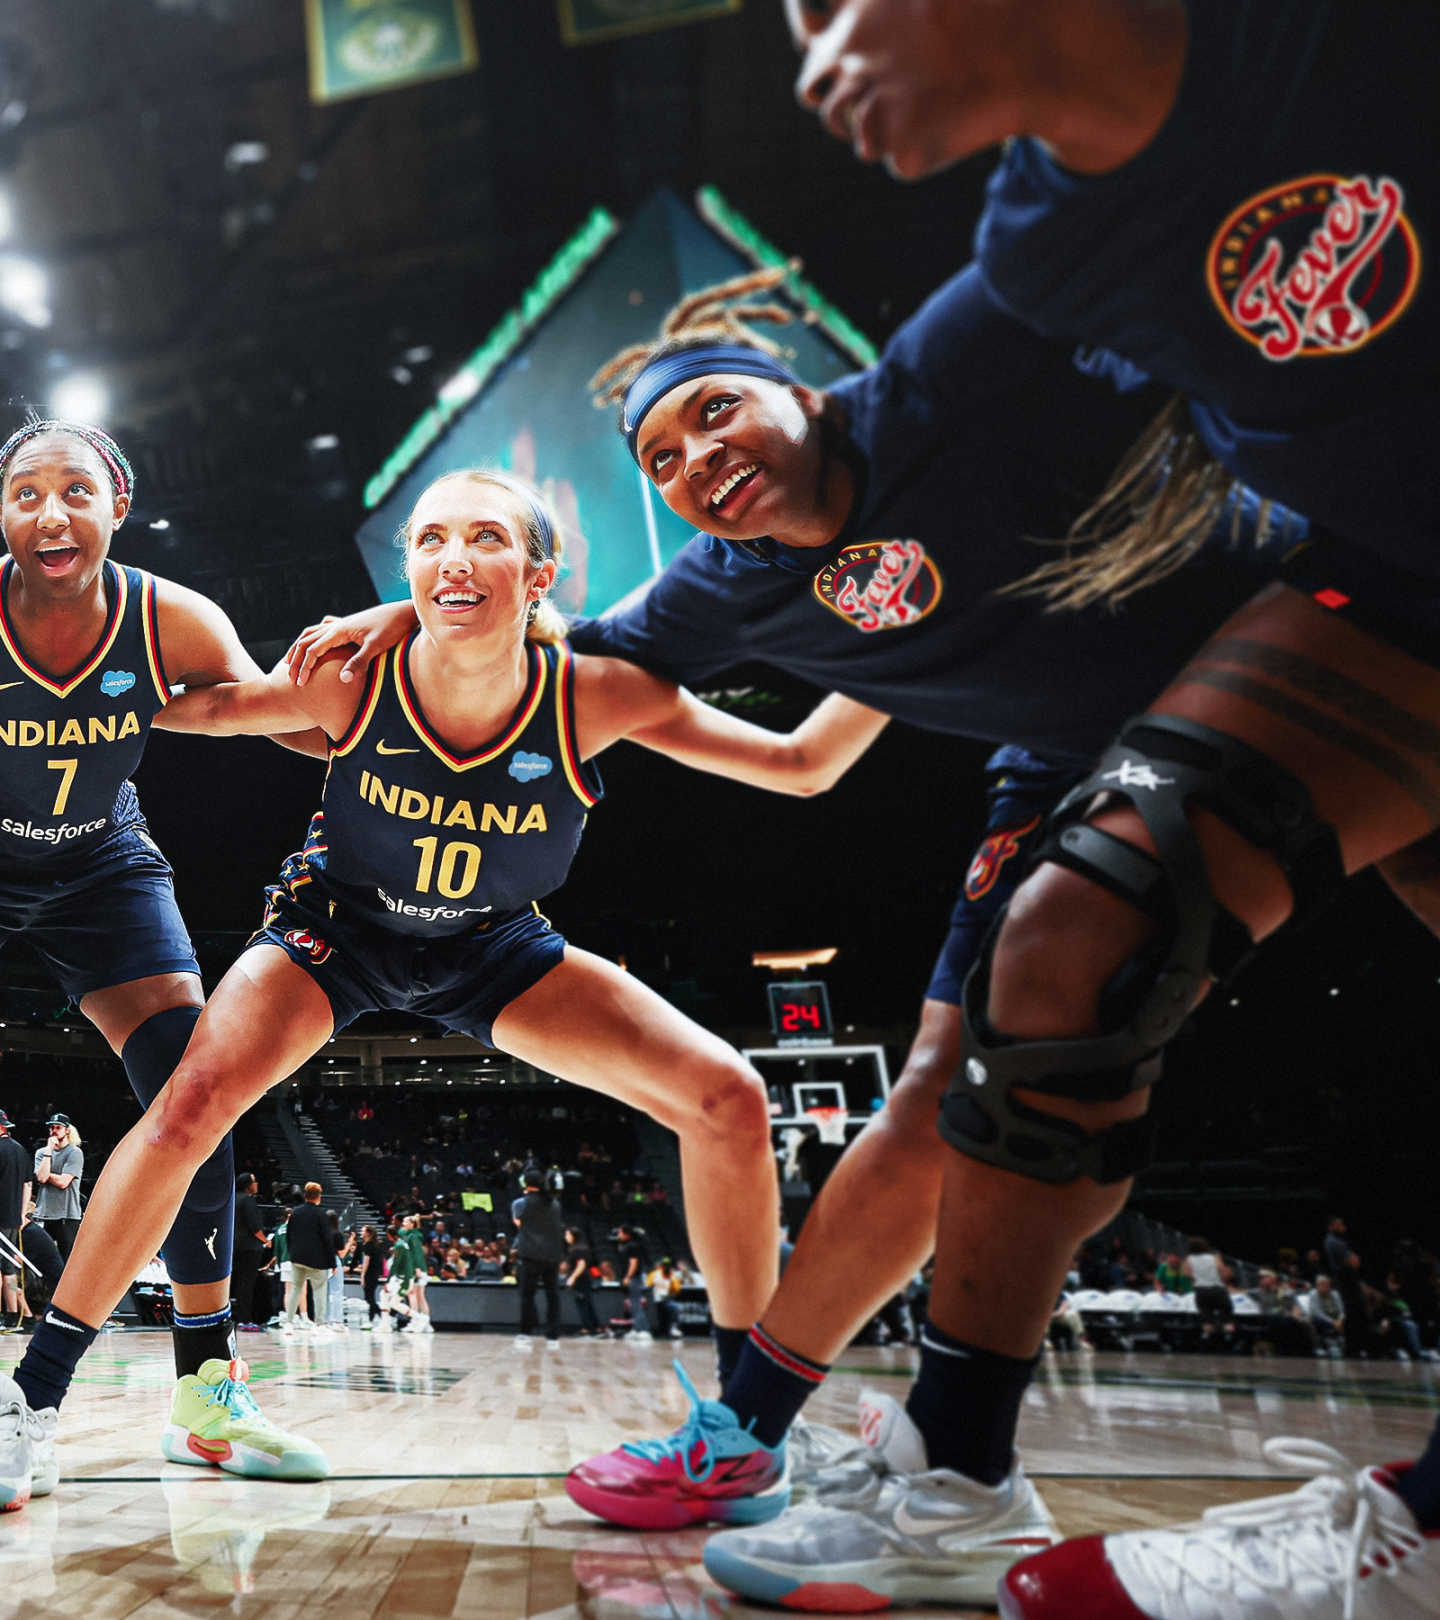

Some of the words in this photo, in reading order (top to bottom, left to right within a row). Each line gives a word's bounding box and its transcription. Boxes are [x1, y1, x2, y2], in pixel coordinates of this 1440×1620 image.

[1233, 173, 1404, 362] Fever
[820, 547, 879, 599] INDIANA
[836, 538, 926, 633] Fever
[46, 758, 79, 817] 7
[359, 769, 549, 835] INDIANA
[0, 817, 108, 846] salesforce
[412, 835, 483, 900] 10
[376, 886, 493, 921] salesfor
[781, 1003, 822, 1031] 24
